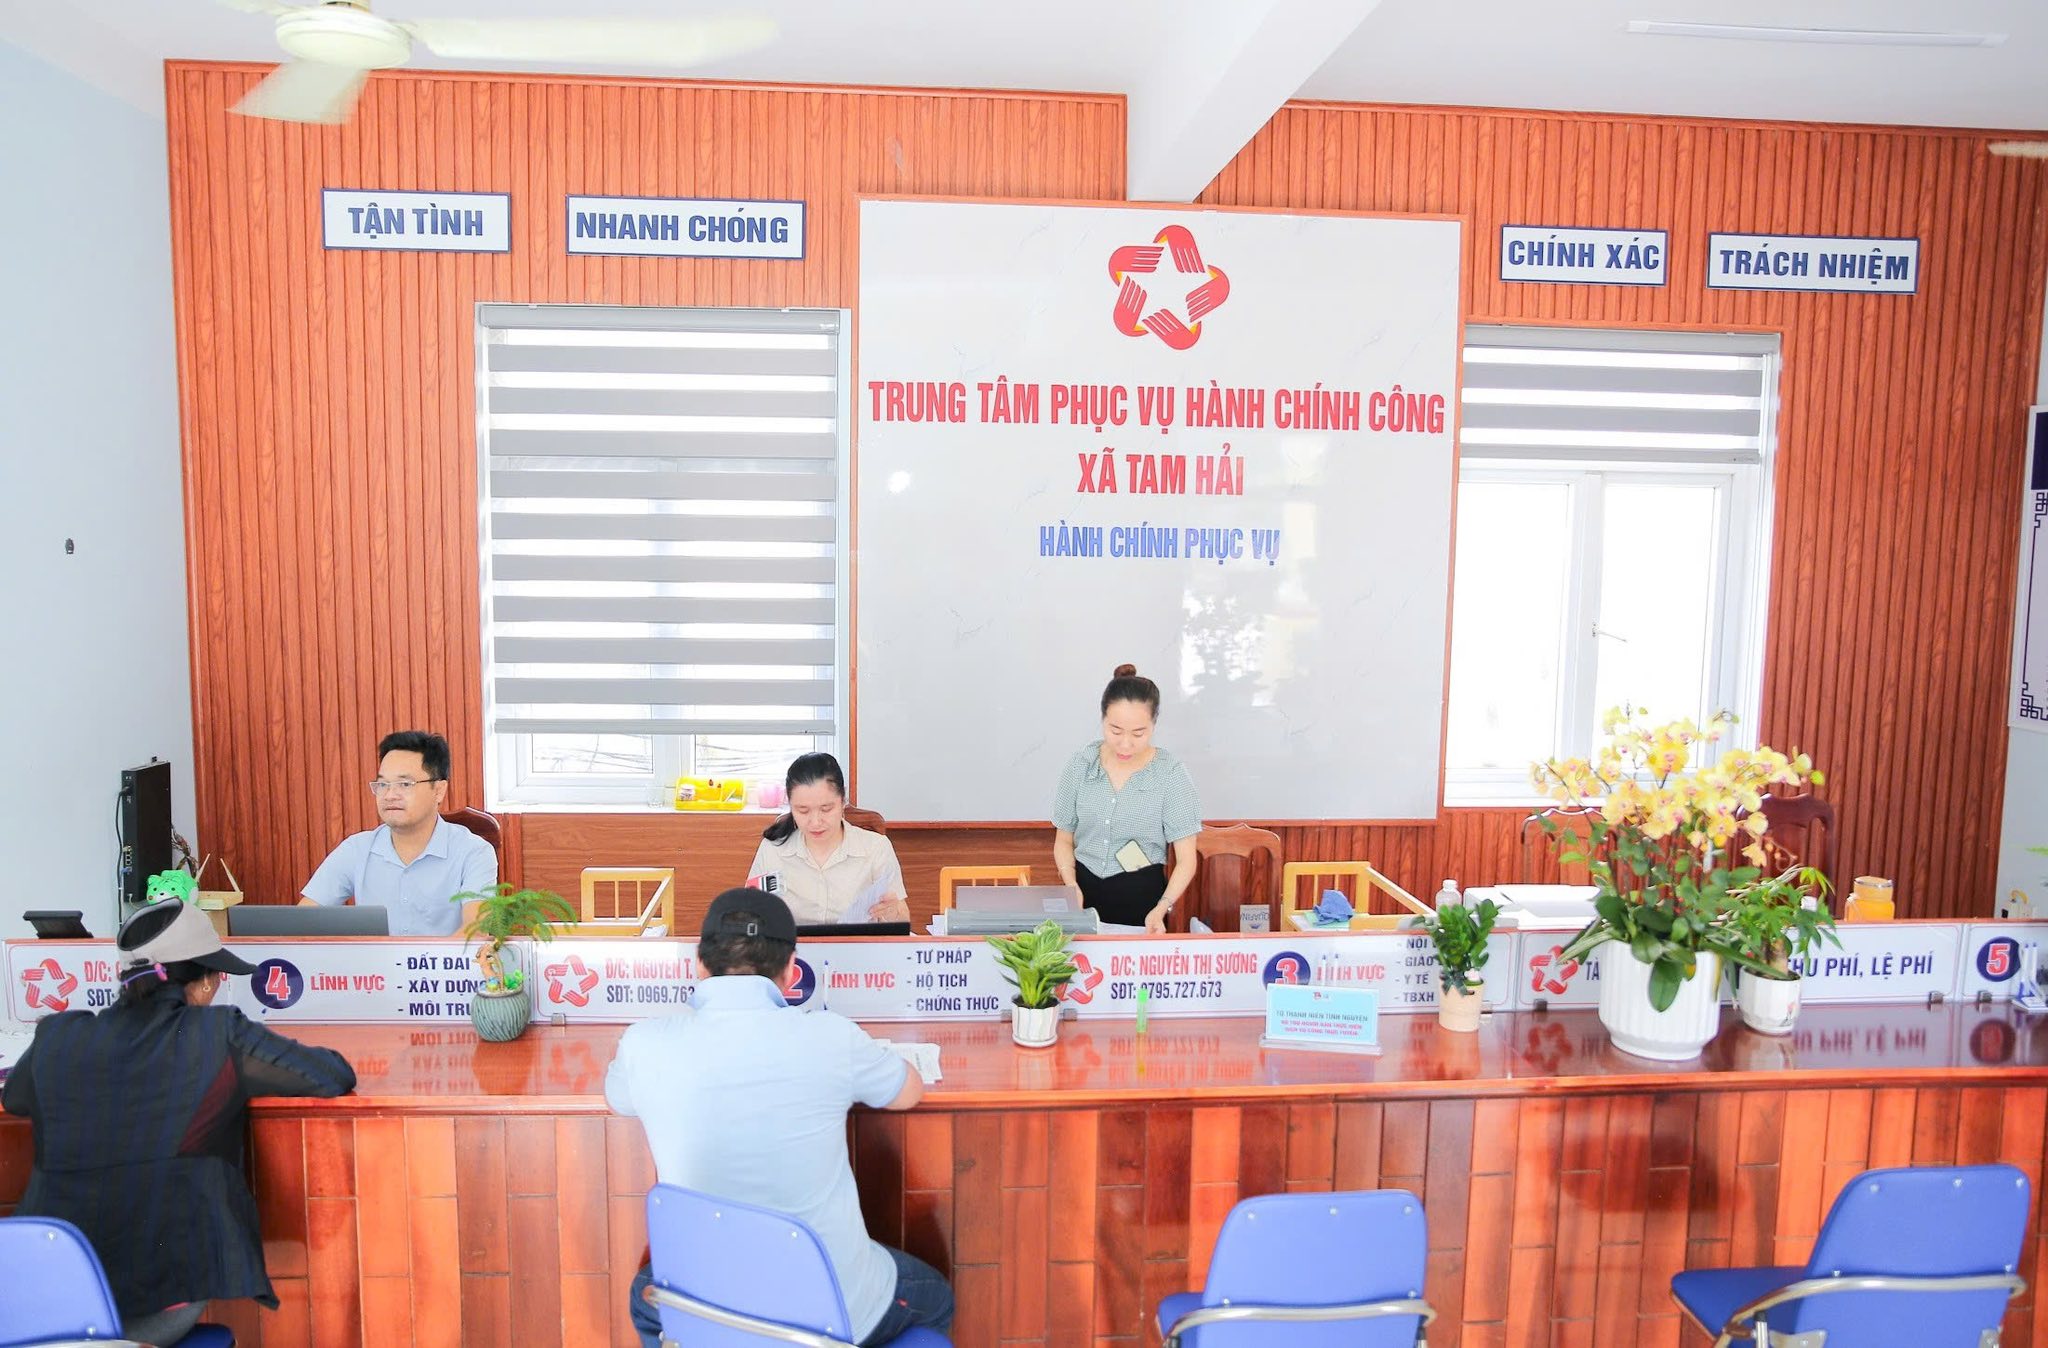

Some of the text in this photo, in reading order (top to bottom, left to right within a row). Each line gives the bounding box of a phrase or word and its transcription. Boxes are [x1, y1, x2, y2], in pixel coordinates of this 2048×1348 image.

[348, 203, 483, 239] TẬN TÌNH
[576, 208, 788, 243] NHANH CHÓNG
[1508, 235, 1660, 269] CHÍNH XÁC
[1720, 243, 1910, 284] TRÁCH NHIỆM
[868, 375, 1445, 434] TRUNG TÂM PHỤC VỤ HÀNH CHÍNH CÔNG
[1077, 442, 1244, 495] XÃ TAM HẢI
[1040, 520, 1280, 566] HÀNH CHÍNH PHỤC VỤ
[1407, 936, 1427, 950] NỘI
[407, 952, 470, 970] ĐẤT ĐAI
[916, 948, 972, 964] TƯ PHÁP
[1111, 956, 1135, 976] Đ/C:
[1139, 947, 1190, 976] NGUYỄN
[1193, 954, 1212, 979] THỊ
[1825, 953, 1863, 978] PHÍ,
[1871, 952, 1893, 979] LỆ
[1900, 951, 1934, 975] PHÍ
[1986, 943, 2010, 977] 5
[84, 961, 112, 982] Đ/C:
[606, 958, 629, 978] Đ/C:
[1275, 957, 1299, 985] 3
[1356, 964, 1385, 982] VỰC
[266, 966, 290, 1000] 4
[311, 973, 385, 994] LĨNH VỰC
[409, 976, 439, 993] XÂY
[783, 964, 803, 998] 2
[864, 972, 895, 991] VỰC
[916, 972, 967, 990] HỘ TỊCH
[1111, 983, 1136, 999] SĐT:
[607, 985, 633, 1003] SĐT:
[916, 995, 999, 1013] CHỨNG THỰC
[1403, 992, 1434, 1002] TBXH
[410, 999, 440, 1016] MÔI
